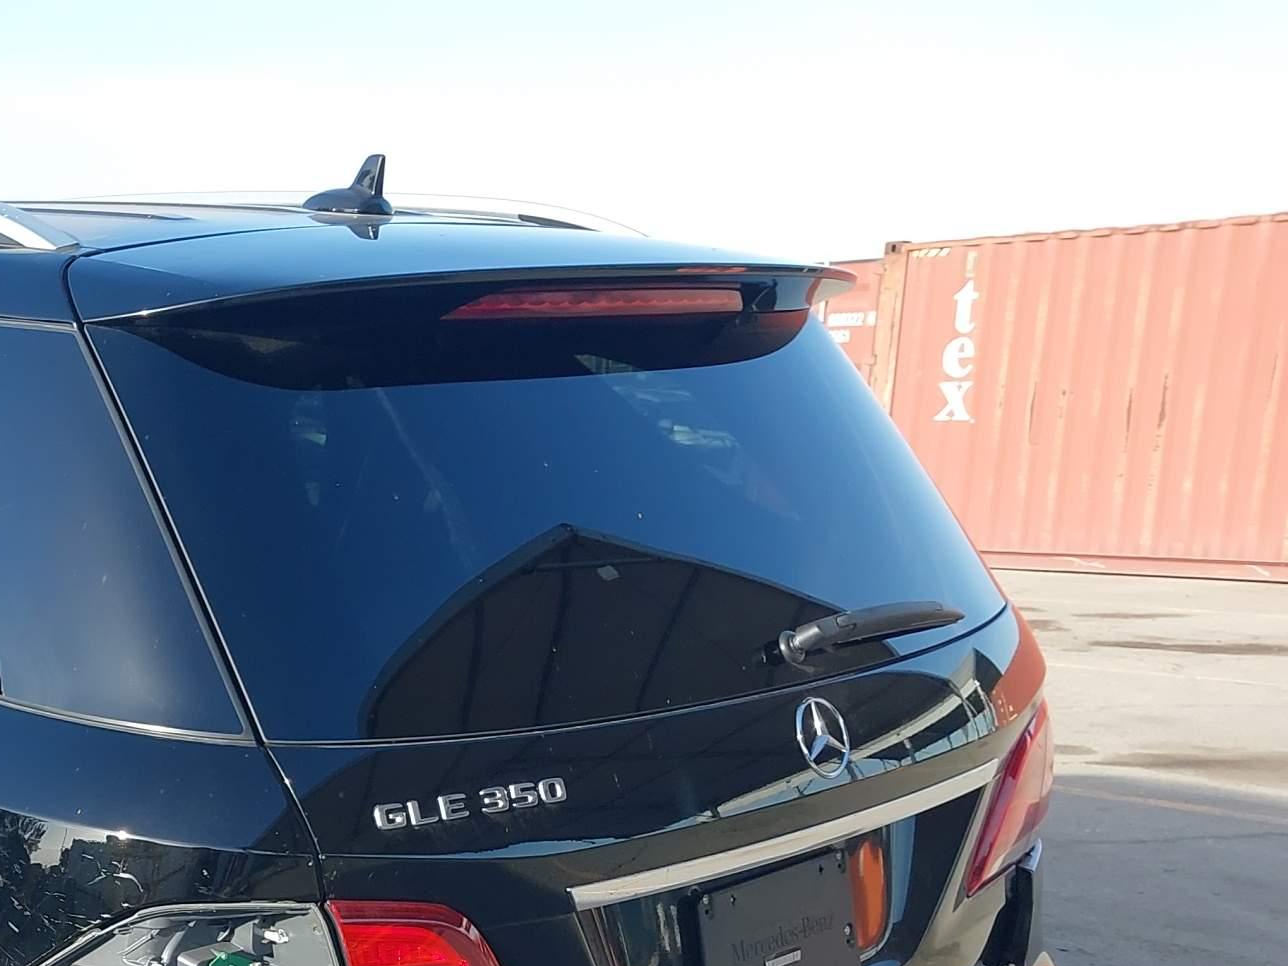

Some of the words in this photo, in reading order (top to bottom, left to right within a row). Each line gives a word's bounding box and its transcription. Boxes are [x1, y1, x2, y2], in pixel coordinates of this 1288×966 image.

[373, 793, 470, 831] GLE
[478, 777, 568, 814] 350
[731, 912, 834, 961] Mercedes-Benz
